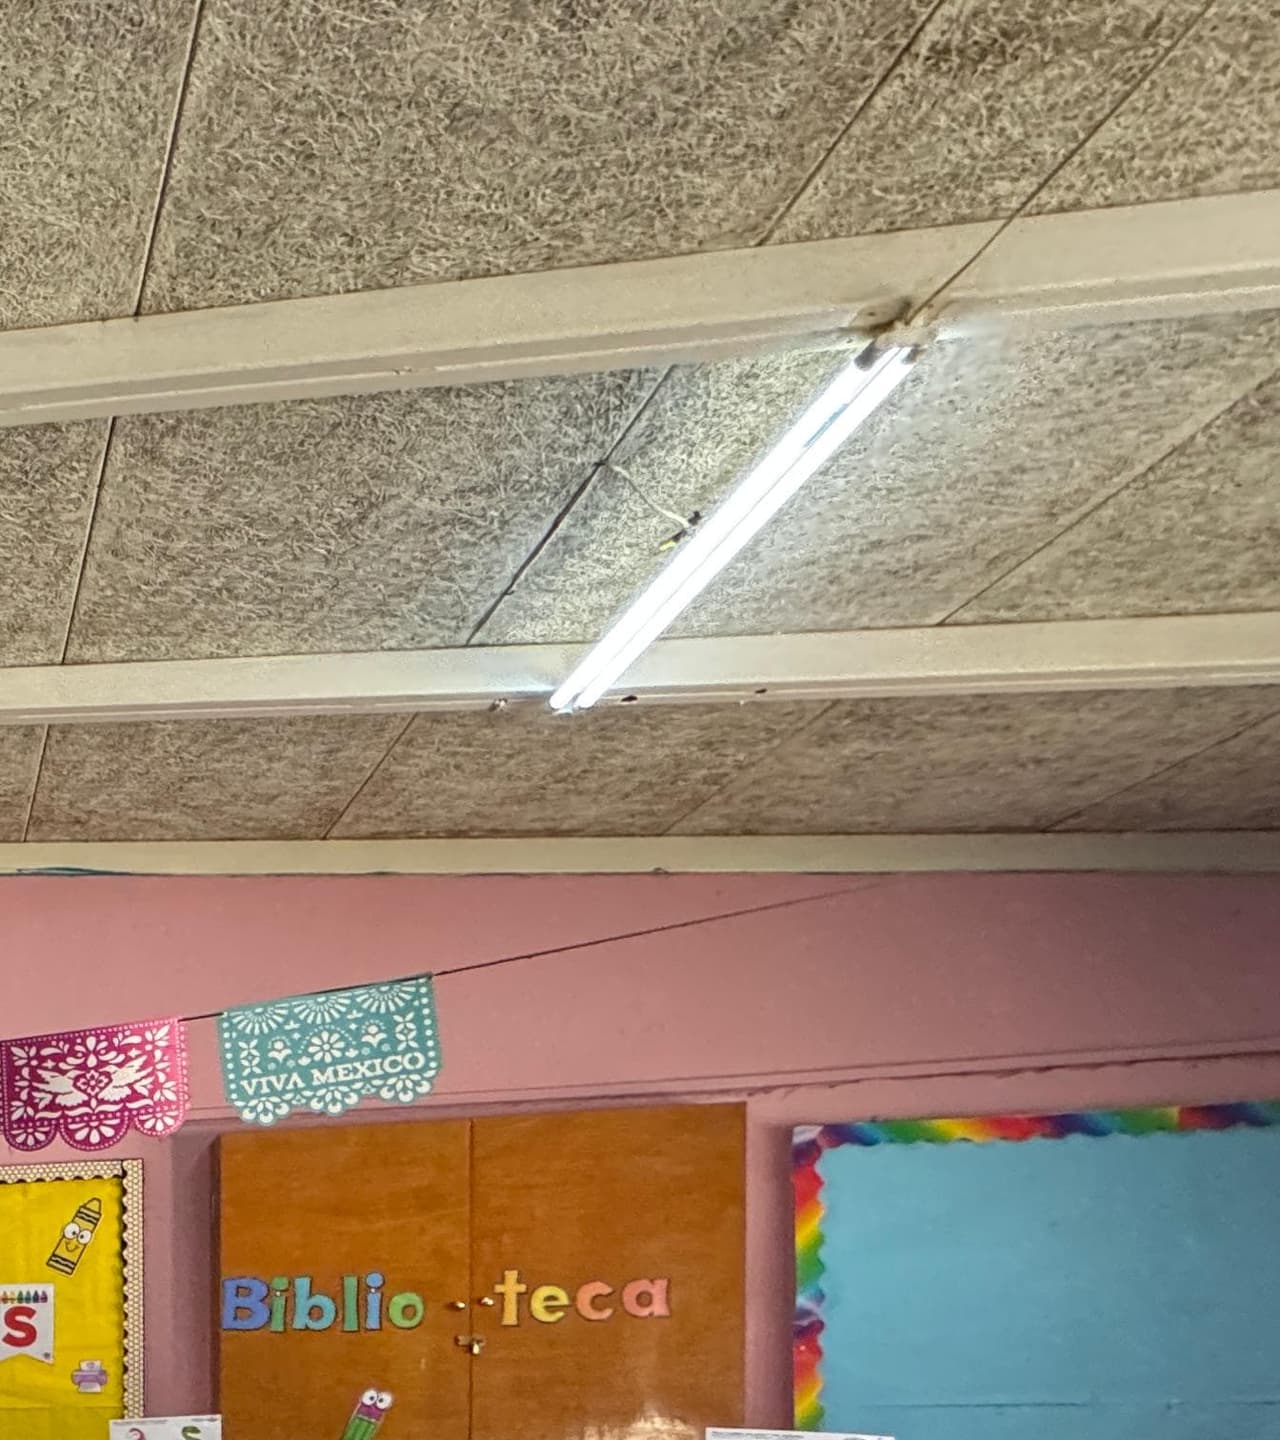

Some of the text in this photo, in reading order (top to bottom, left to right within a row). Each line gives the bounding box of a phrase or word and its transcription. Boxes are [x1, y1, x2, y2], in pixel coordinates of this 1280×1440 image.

[240, 1050, 426, 1098] VIVA MEXICO
[221, 1269, 672, 1333] Biblio teca
